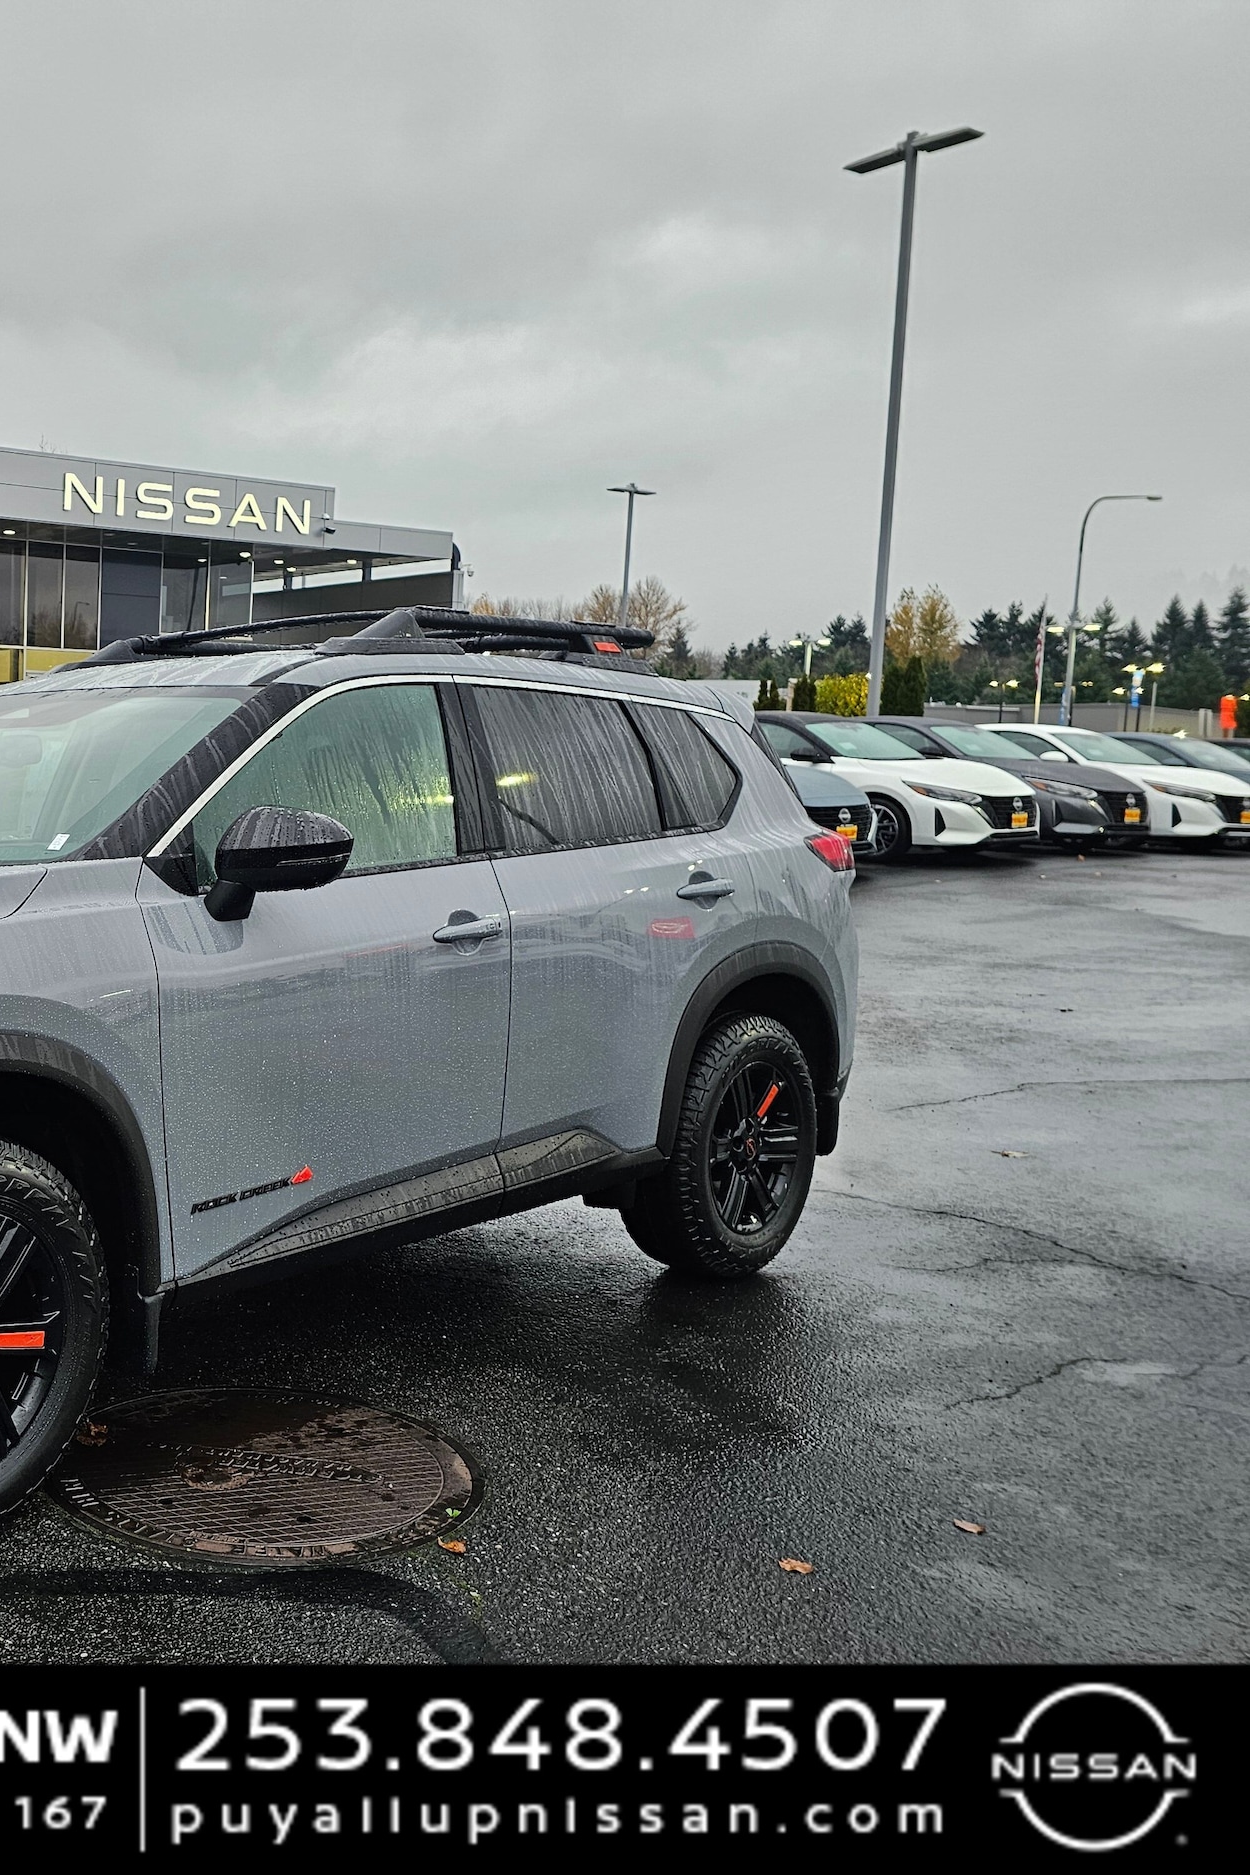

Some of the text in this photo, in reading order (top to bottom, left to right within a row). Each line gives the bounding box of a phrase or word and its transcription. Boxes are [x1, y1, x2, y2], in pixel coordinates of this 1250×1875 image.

[63, 473, 311, 535] NISSAN
[190, 1178, 291, 1215] ROCK CREEK
